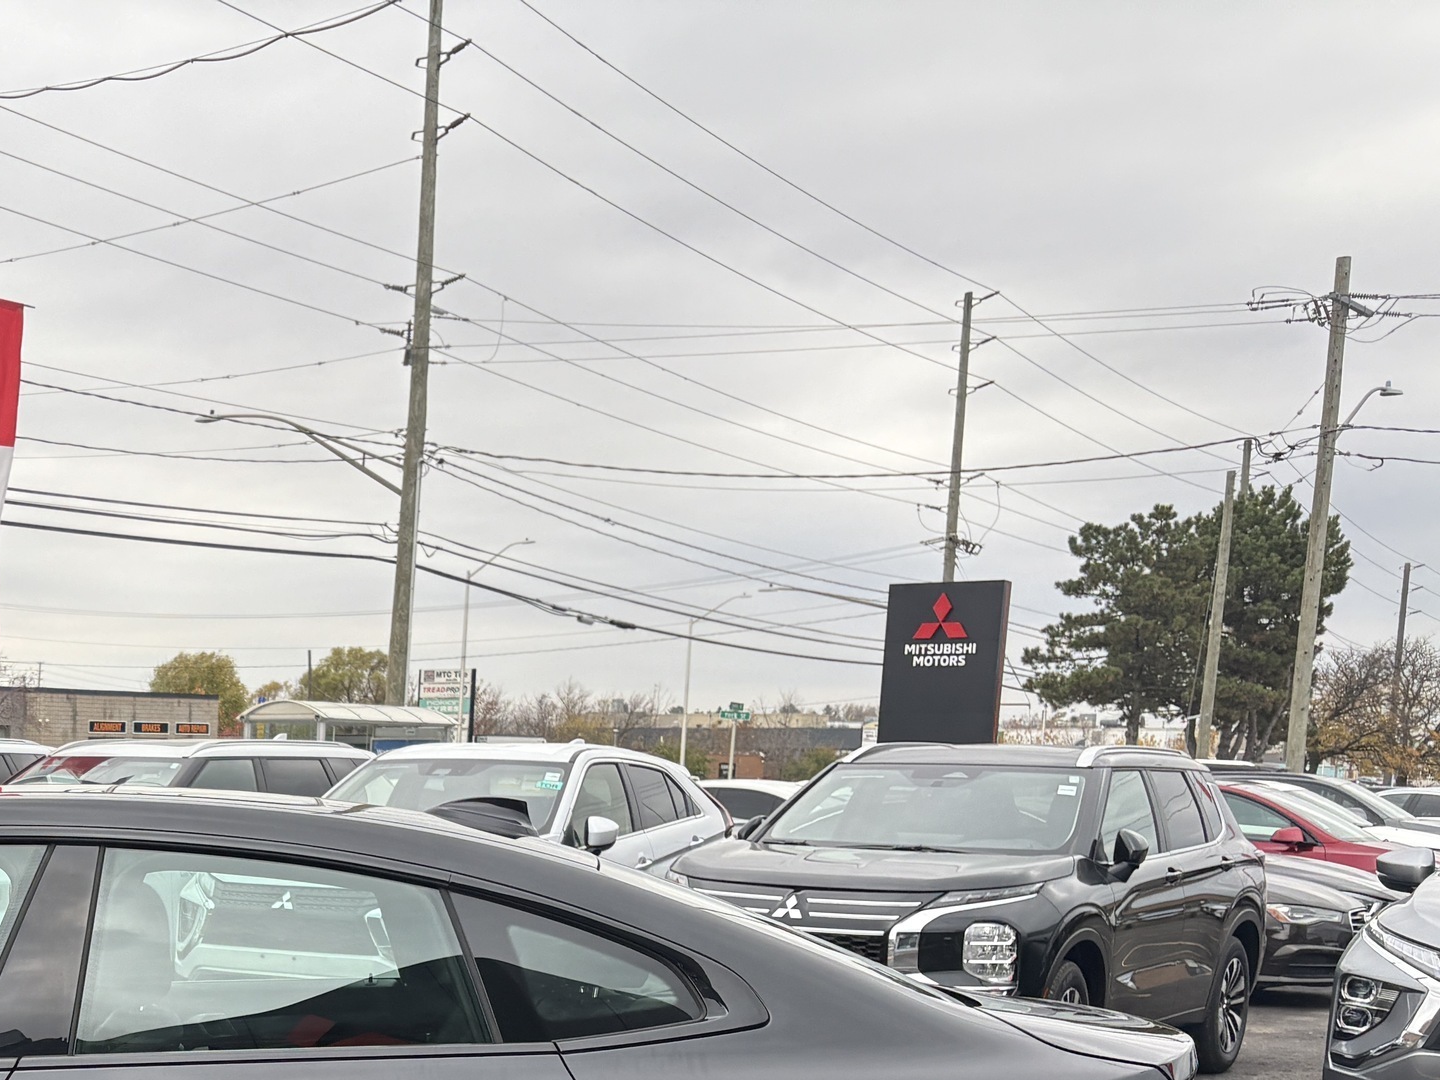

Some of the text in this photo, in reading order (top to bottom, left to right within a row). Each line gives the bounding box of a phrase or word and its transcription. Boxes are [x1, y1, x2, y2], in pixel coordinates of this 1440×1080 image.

[904, 642, 977, 655] MITSUBISHI
[912, 655, 966, 667] MOTORS
[93, 722, 122, 732] ALIGNMENT
[141, 723, 161, 732] BRAKES
[178, 724, 207, 733] AUTO REPAIR
